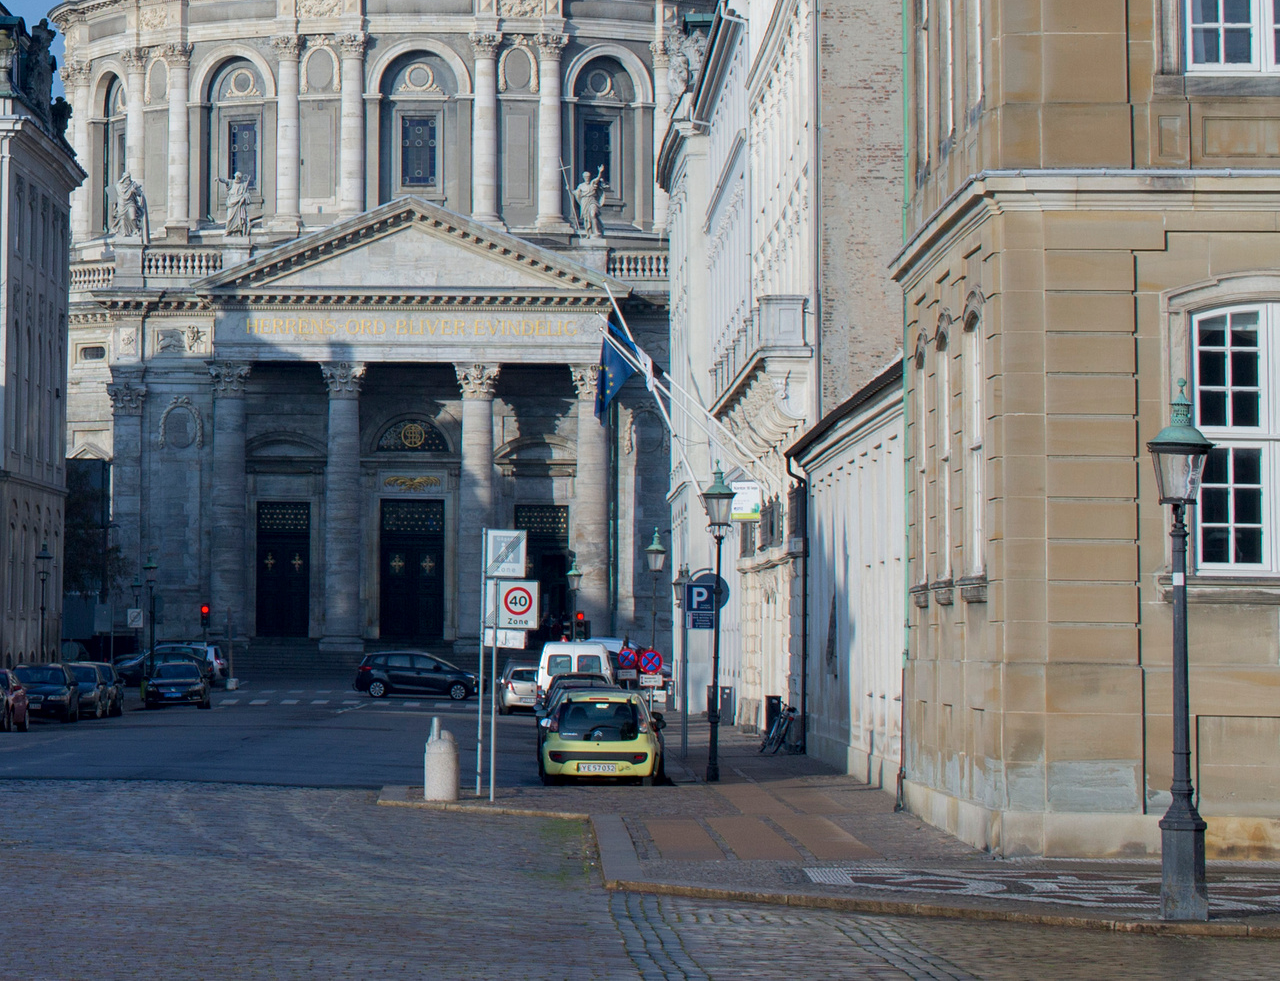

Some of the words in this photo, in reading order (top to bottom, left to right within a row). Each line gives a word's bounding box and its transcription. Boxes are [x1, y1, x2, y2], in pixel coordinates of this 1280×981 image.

[246, 318, 337, 335] HERRENS
[345, 318, 387, 335] ORD
[395, 318, 466, 336] BLIVER
[473, 319, 578, 337] EVINDELIG
[509, 595, 528, 607] 40
[692, 587, 709, 609] P
[507, 617, 529, 625] Zone
